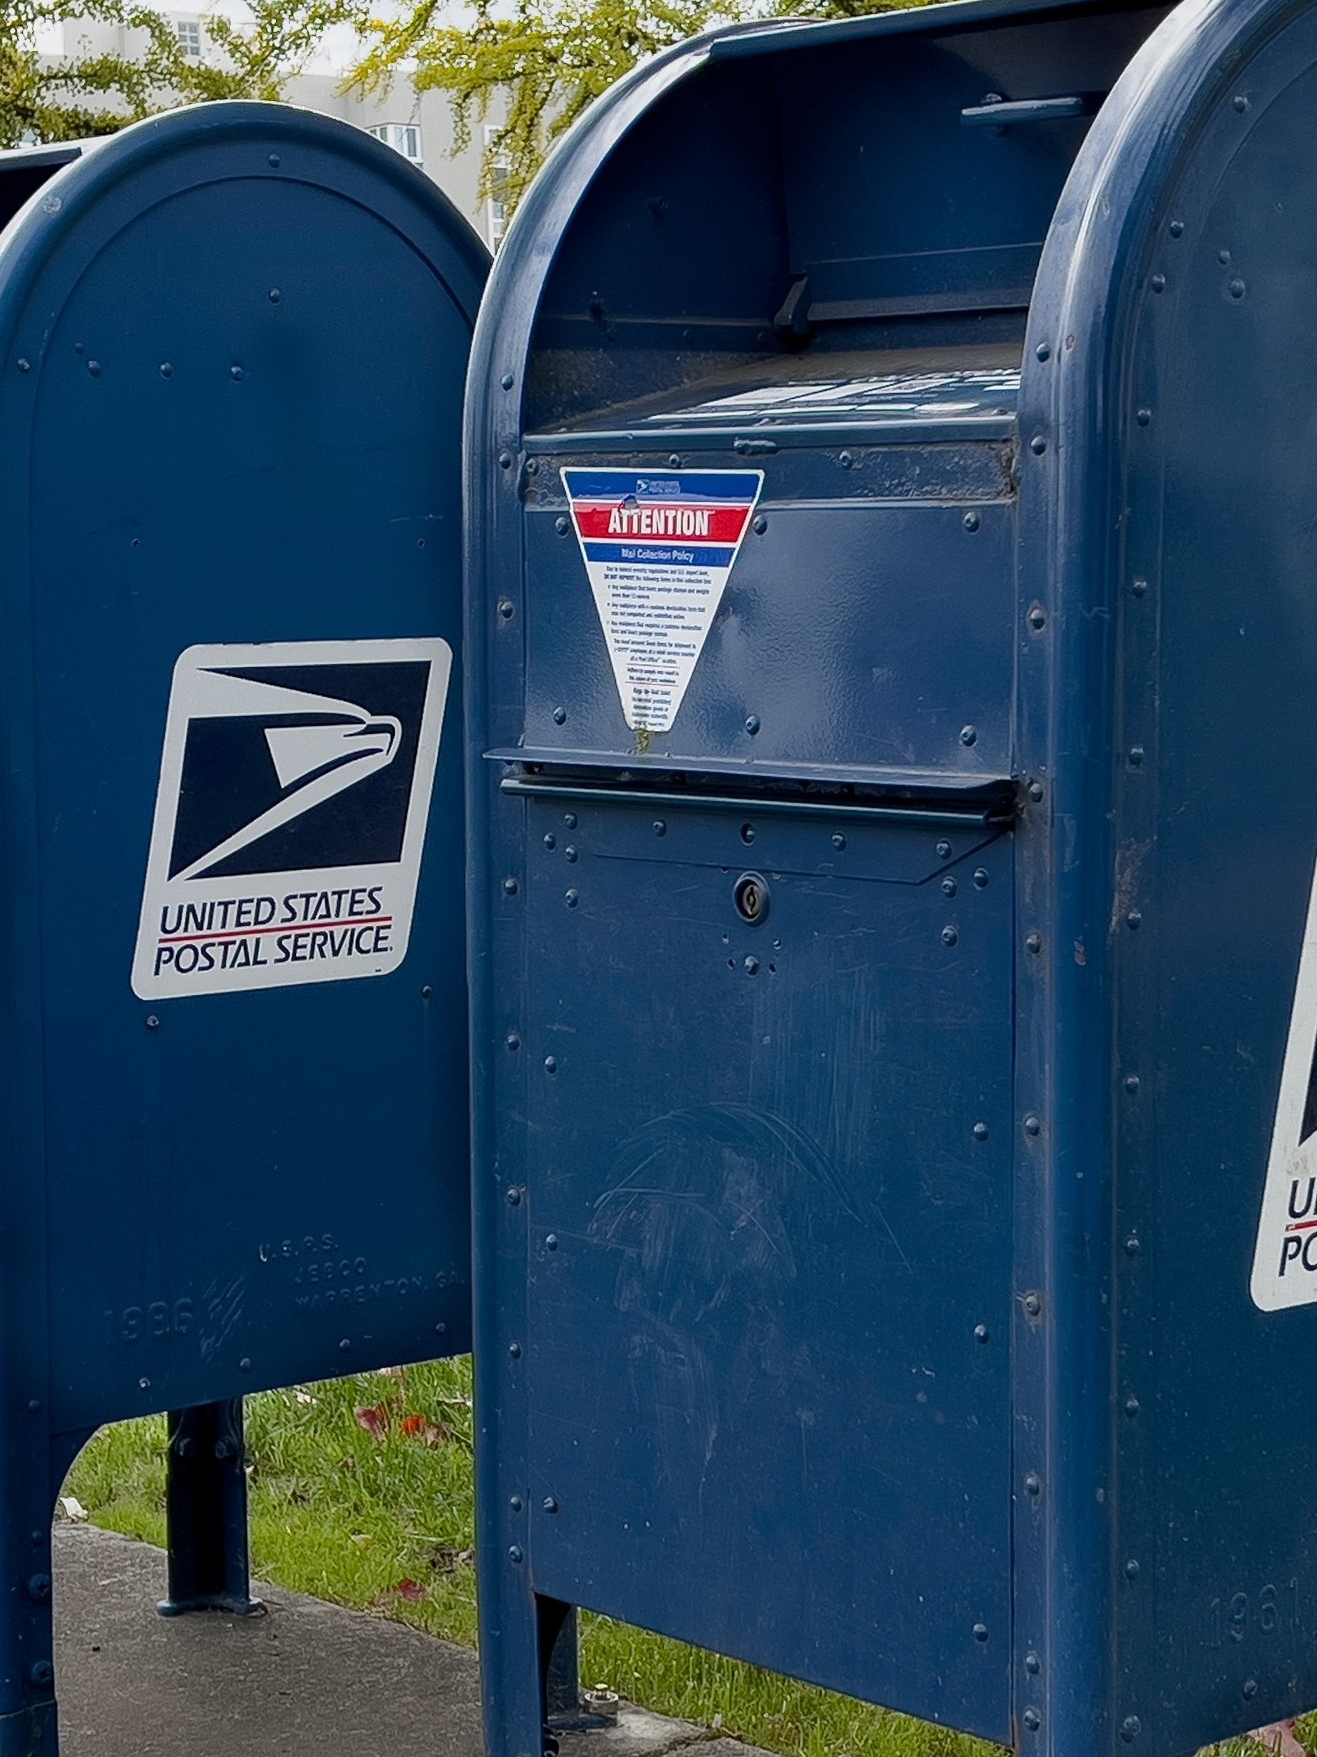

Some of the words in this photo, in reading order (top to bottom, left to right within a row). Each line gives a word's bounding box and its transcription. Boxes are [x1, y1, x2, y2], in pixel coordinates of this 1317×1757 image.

[607, 507, 711, 536] ATTENTION
[637, 548, 672, 561] Collection
[672, 550, 695, 563] Policy
[160, 896, 276, 935] UNITED
[280, 886, 383, 923] STATES
[154, 937, 268, 977] POSTAL
